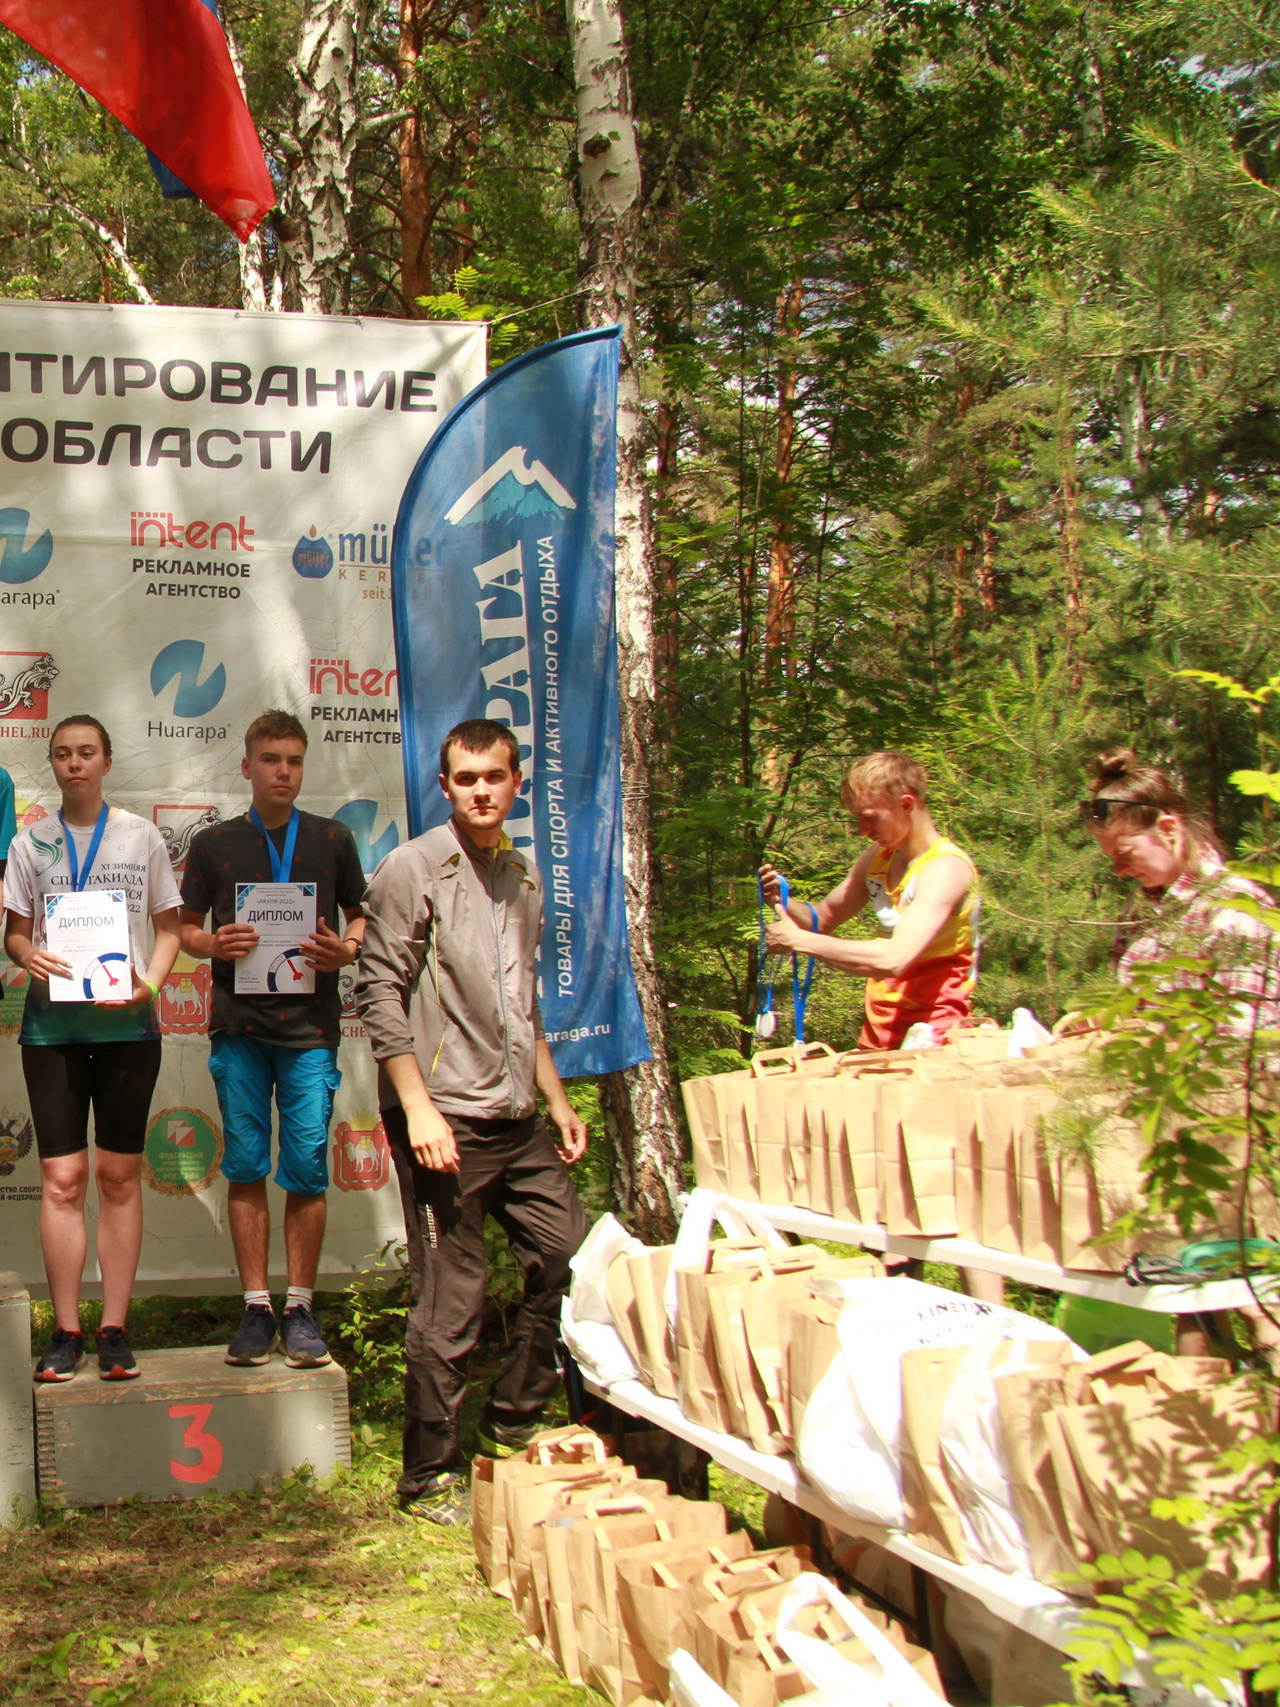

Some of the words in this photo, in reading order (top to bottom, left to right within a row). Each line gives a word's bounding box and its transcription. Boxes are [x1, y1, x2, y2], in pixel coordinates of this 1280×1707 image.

[0, 417, 333, 474] ОБЛАСТИ
[130, 511, 256, 552] intent
[131, 558, 251, 579] РЕКЛАМНОЕ
[536, 535, 561, 623] ОТДЫХА
[145, 582, 241, 600] АГЕНТСТВО
[362, 586, 385, 600] seit
[544, 629, 562, 753] АКТИВНОГО
[311, 706, 399, 722] РЕКЛАМН
[323, 730, 402, 744] АГЕНТСТВ
[545, 758, 562, 773] И
[548, 778, 569, 859] СПОРТА
[112, 863, 146, 872] ЗИМНЯЯ
[51, 873, 144, 886] СПАТАКИАДА
[552, 865, 574, 908] ДЛЯ
[58, 916, 115, 930] ДИПЛОМ
[247, 910, 304, 923] ДИПЛОМ
[555, 912, 573, 998] ТОВАРЫ
[7, 1194, 43, 1202] ФЕДЕРАЦИ
[425, 1203, 438, 1249] noname
[169, 1403, 223, 1483] 3
